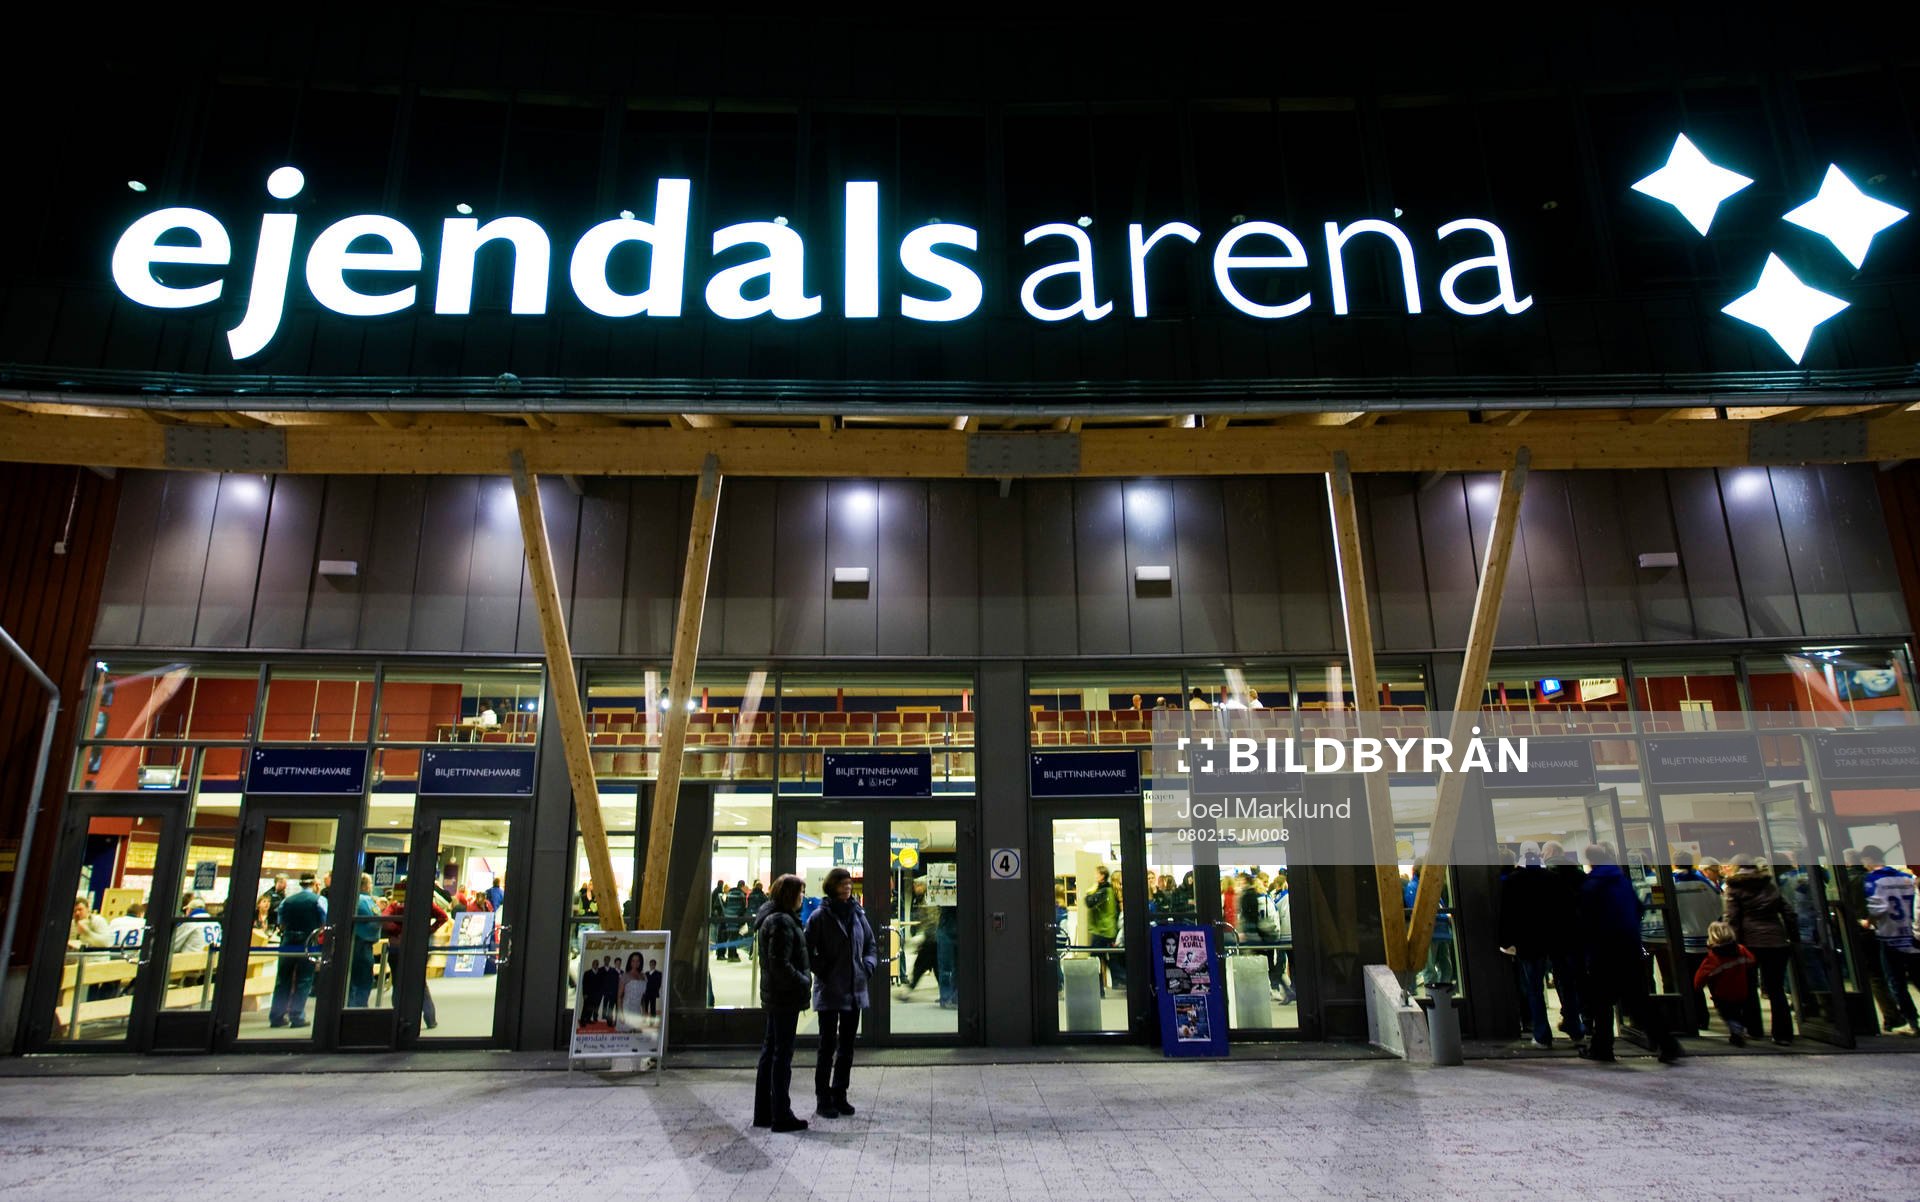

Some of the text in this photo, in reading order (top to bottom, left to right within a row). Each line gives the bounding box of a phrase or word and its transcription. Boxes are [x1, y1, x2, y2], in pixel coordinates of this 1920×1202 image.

[112, 167, 1533, 360] ejendals arena
[1661, 755, 1749, 767] BILJETTINNEHAVARE
[263, 766, 352, 777] BILJETTINNEHAVARE
[435, 767, 522, 778] BILJETTINNEHAVARE
[835, 767, 919, 777] BILJETTINNEHAVARE
[1043, 769, 1127, 780] BILJETTINNEHAVARE
[878, 778, 897, 786] HCP
[1000, 855, 1010, 872] 4
[113, 929, 139, 946] 18
